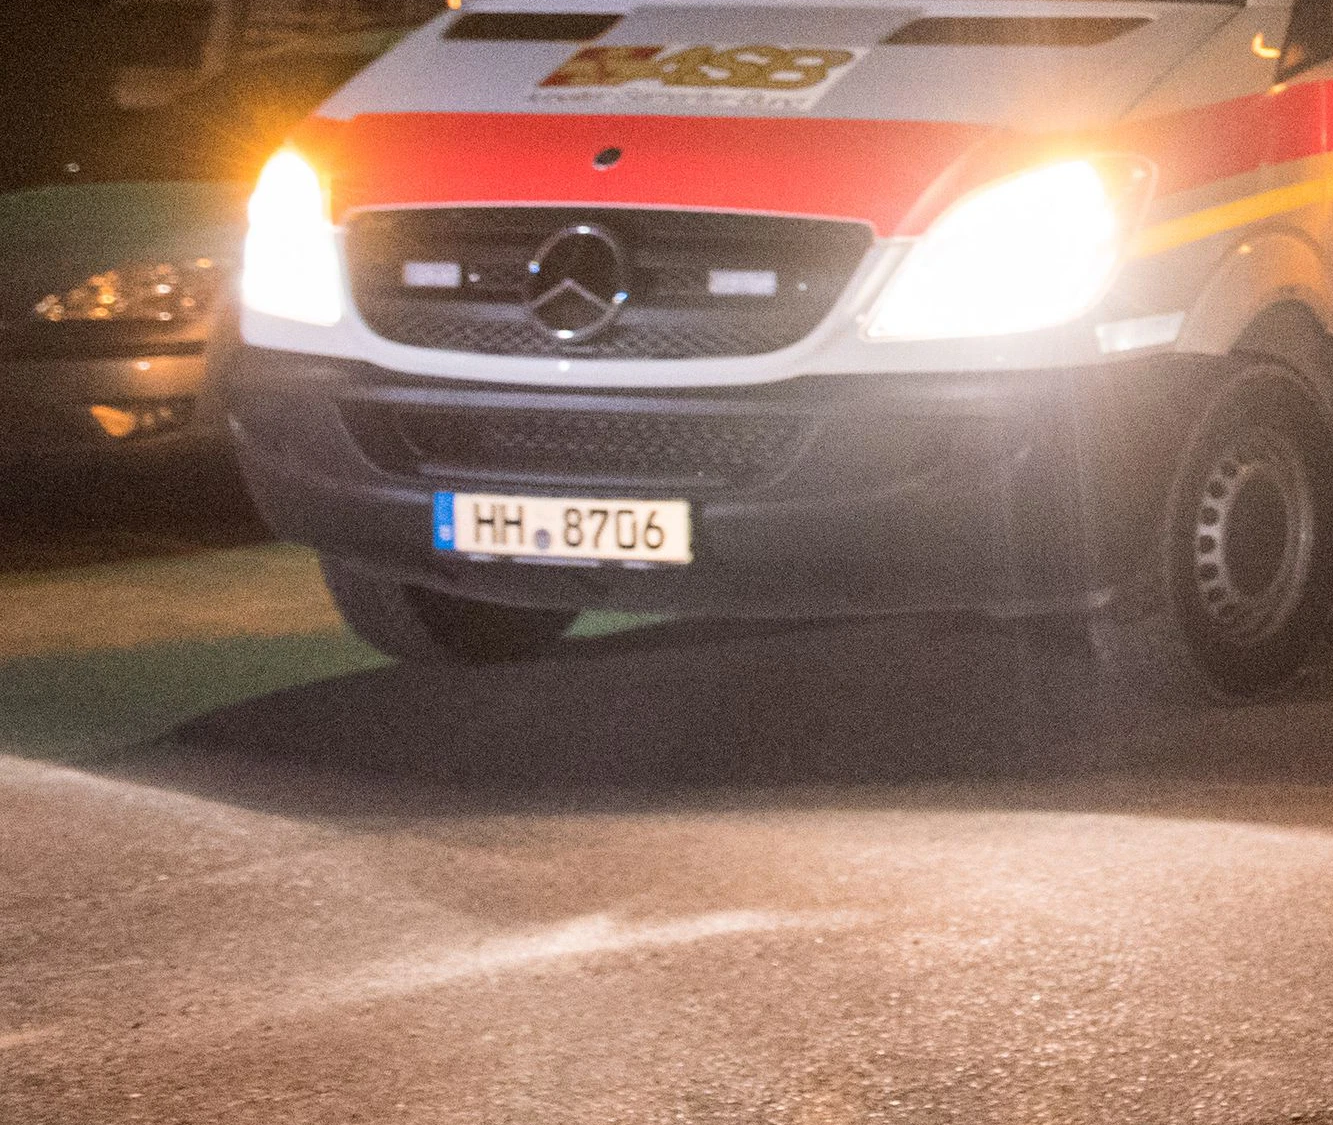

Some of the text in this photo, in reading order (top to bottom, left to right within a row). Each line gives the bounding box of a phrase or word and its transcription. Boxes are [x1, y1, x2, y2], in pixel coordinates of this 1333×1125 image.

[618, 45, 853, 90] ASB
[472, 503, 665, 550] HH 8706
